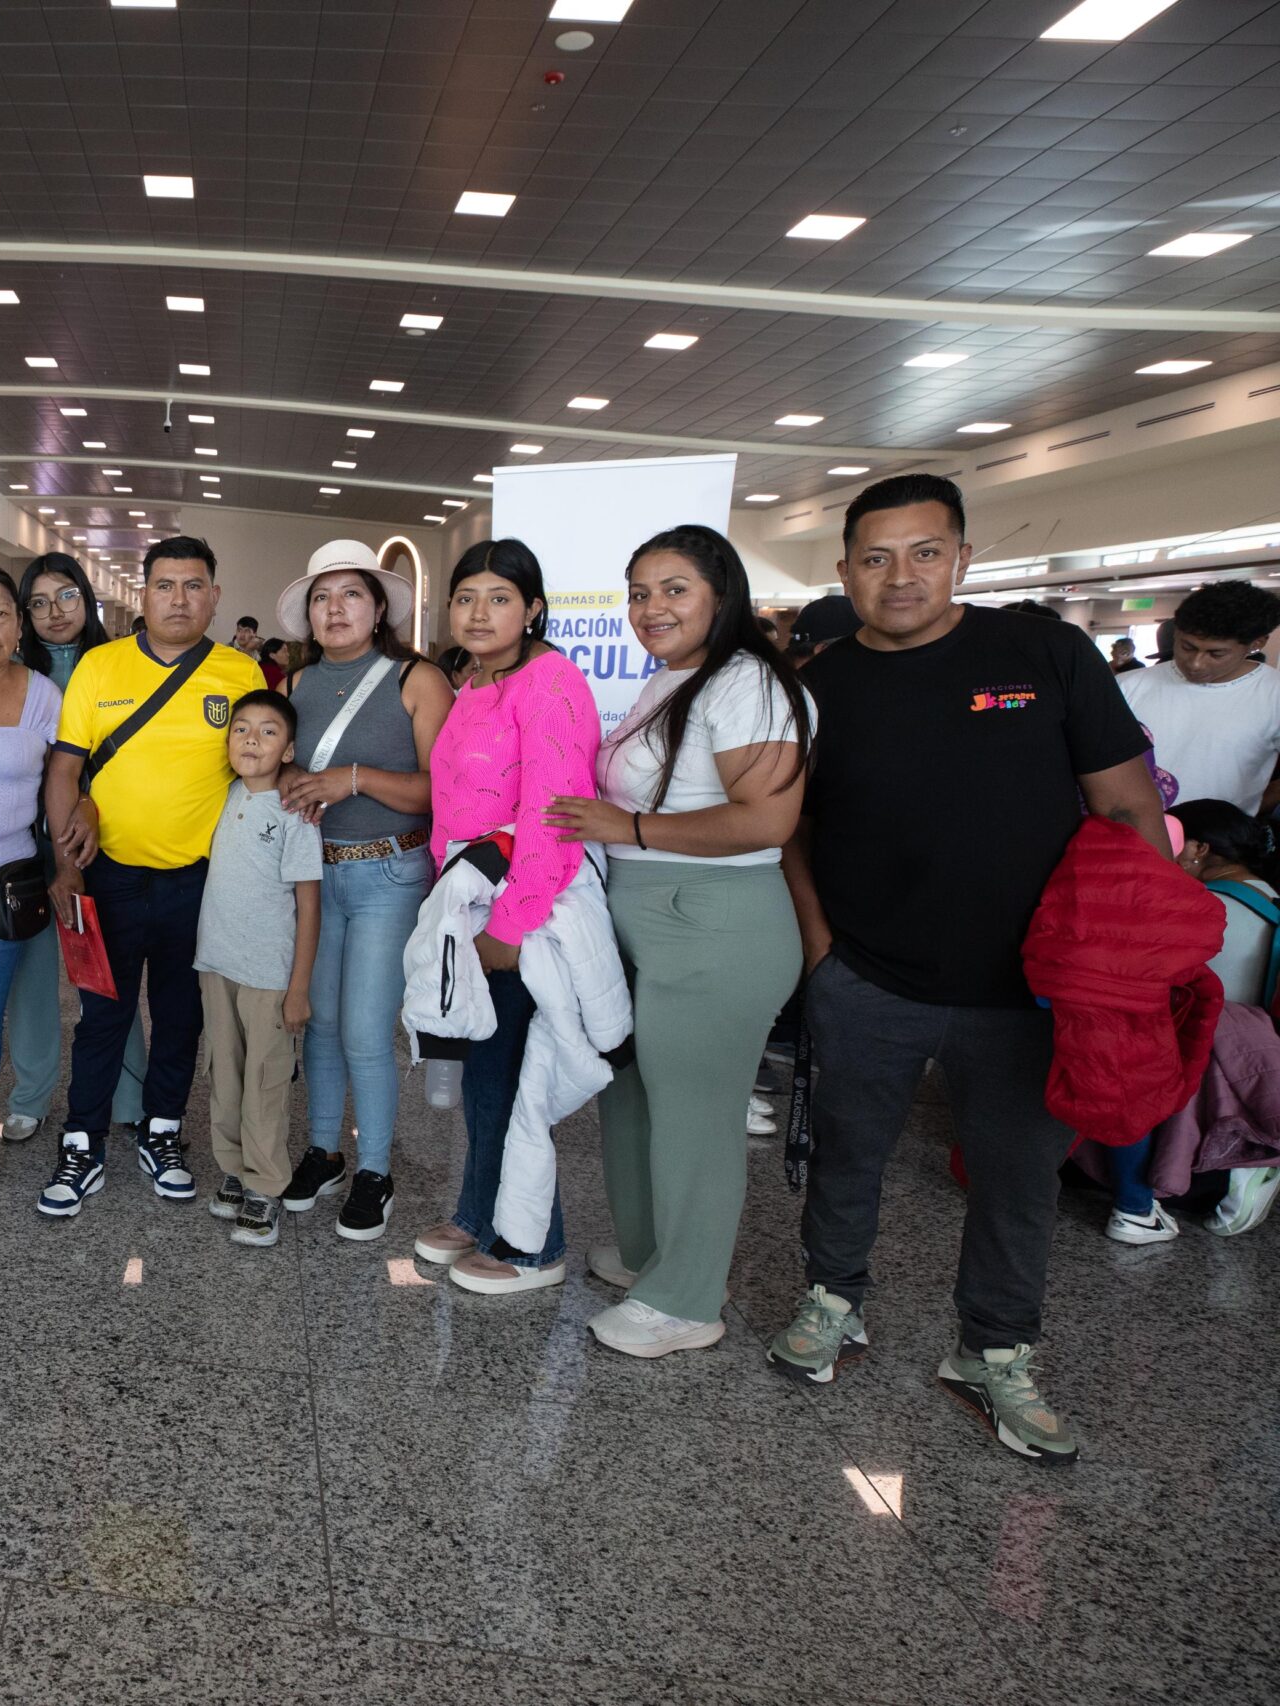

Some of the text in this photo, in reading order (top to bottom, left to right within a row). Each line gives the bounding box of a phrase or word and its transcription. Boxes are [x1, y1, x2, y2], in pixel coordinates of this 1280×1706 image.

[548, 595, 613, 605] GRAMAS DE
[548, 613, 623, 638] RACIÓN
[557, 645, 666, 680] CULA
[98, 698, 135, 708] ECUADOR
[599, 710, 627, 721] idad
[311, 738, 334, 772] INRUN
[789, 1089, 804, 1145] VOLKSWAGEN
